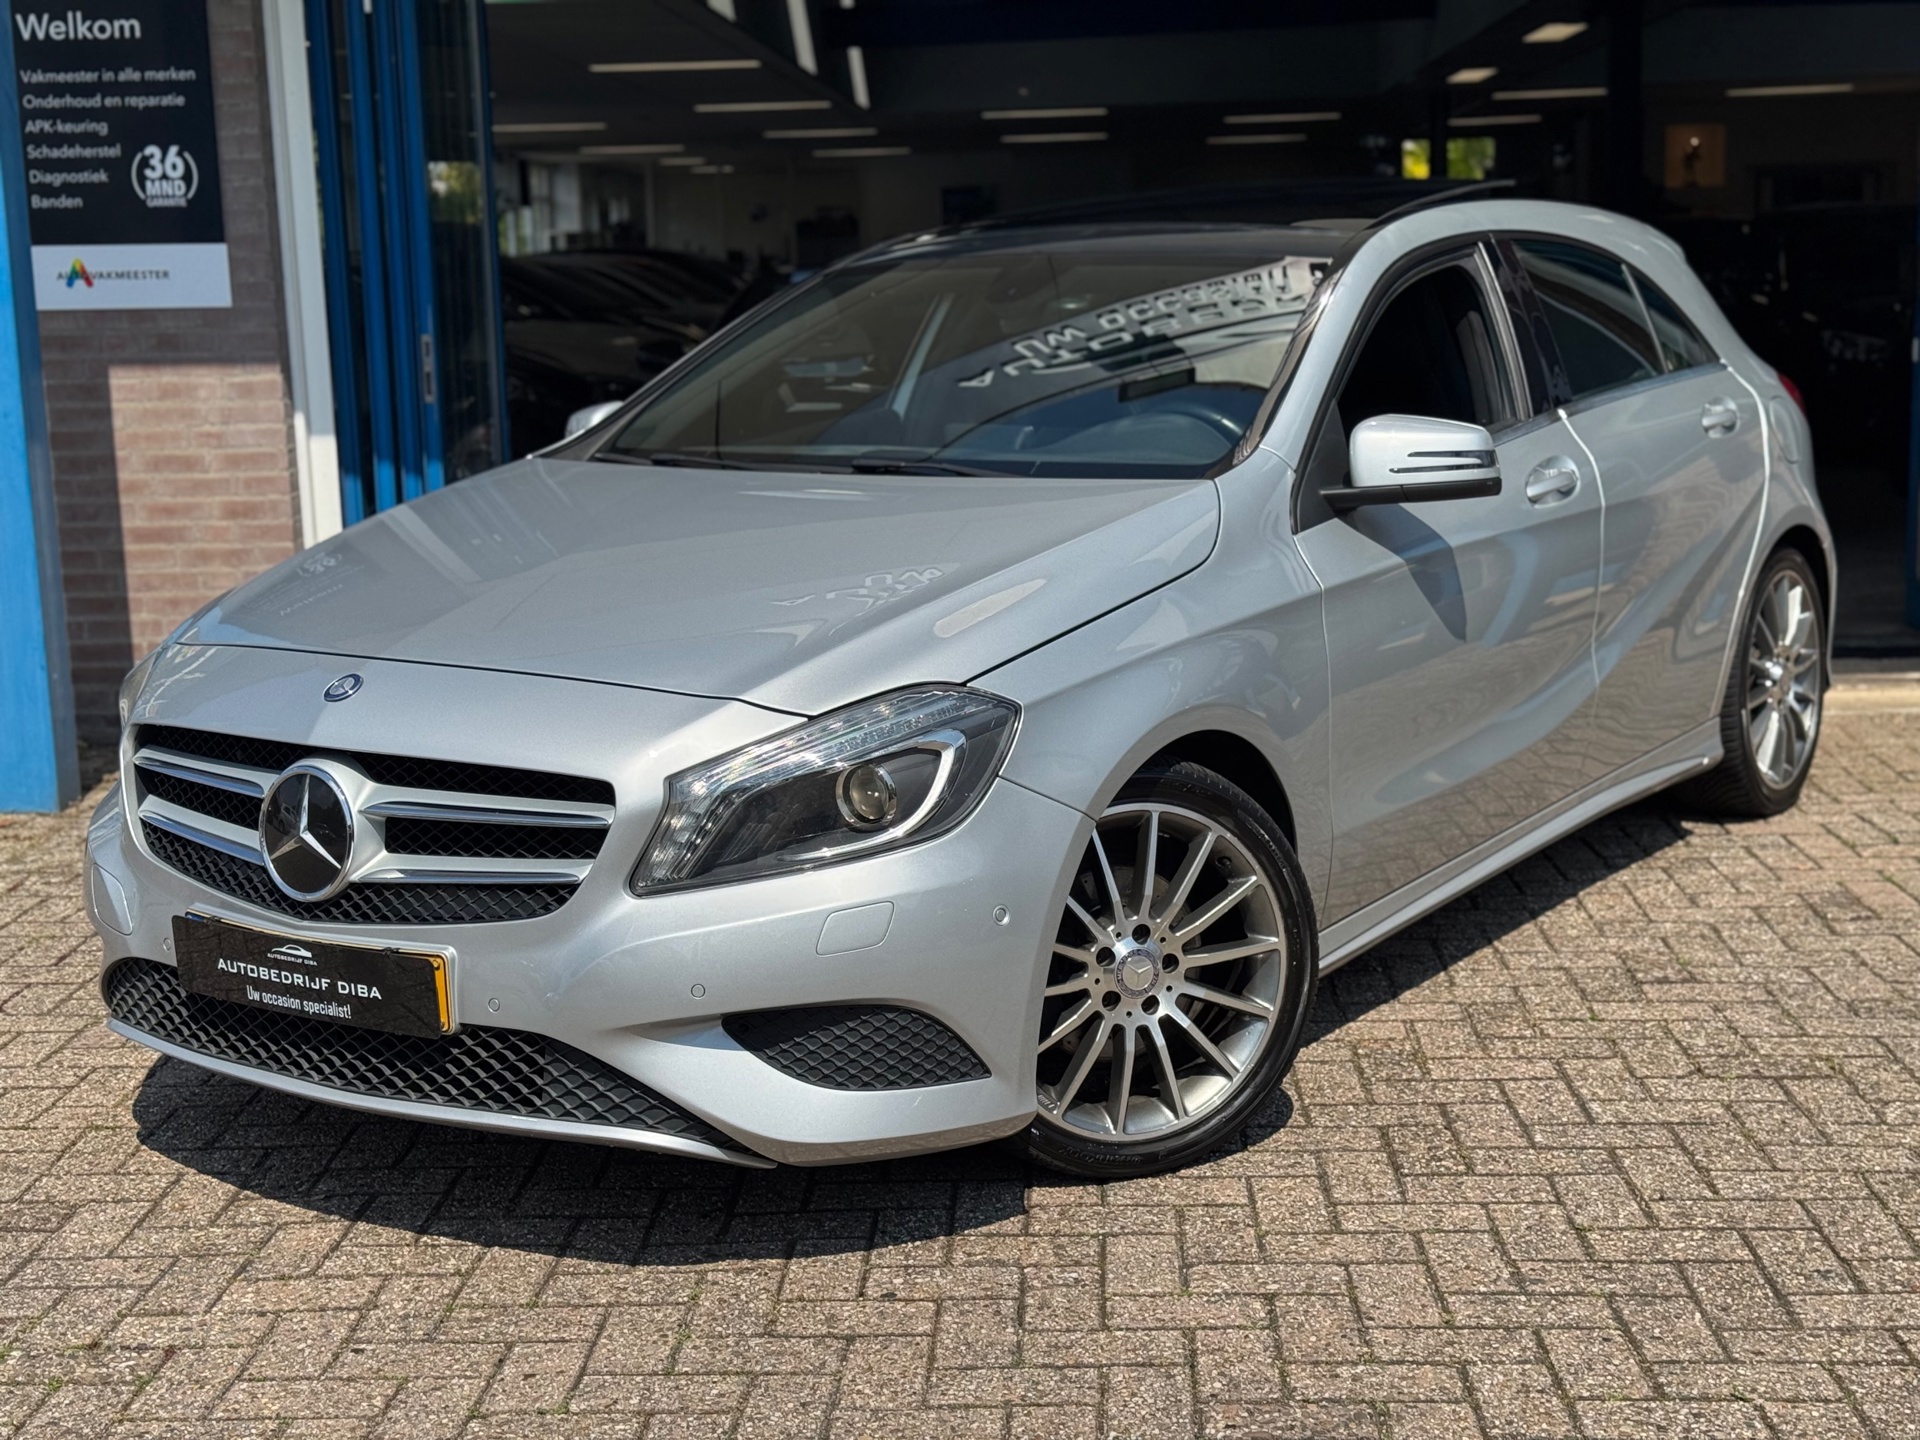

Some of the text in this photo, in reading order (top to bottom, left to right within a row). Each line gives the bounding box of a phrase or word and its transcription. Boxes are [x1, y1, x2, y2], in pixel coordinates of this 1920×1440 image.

[15, 10, 142, 41] Welkom
[19, 66, 197, 84] Vakmeester in alle merken
[22, 92, 186, 110] Onderhoud en reparatie
[24, 118, 109, 136] APK-keuring
[26, 143, 122, 159] Schadeherstel
[143, 144, 185, 179] 36
[29, 168, 109, 187] Diagnostiek
[145, 179, 187, 197] MND
[31, 194, 84, 209] Banden
[267, 953, 303, 964] AUTOBEDRIJF
[217, 958, 383, 1000] AUTOBEDRIJF DIBA
[246, 985, 352, 1019] Uw occasion specialist!
